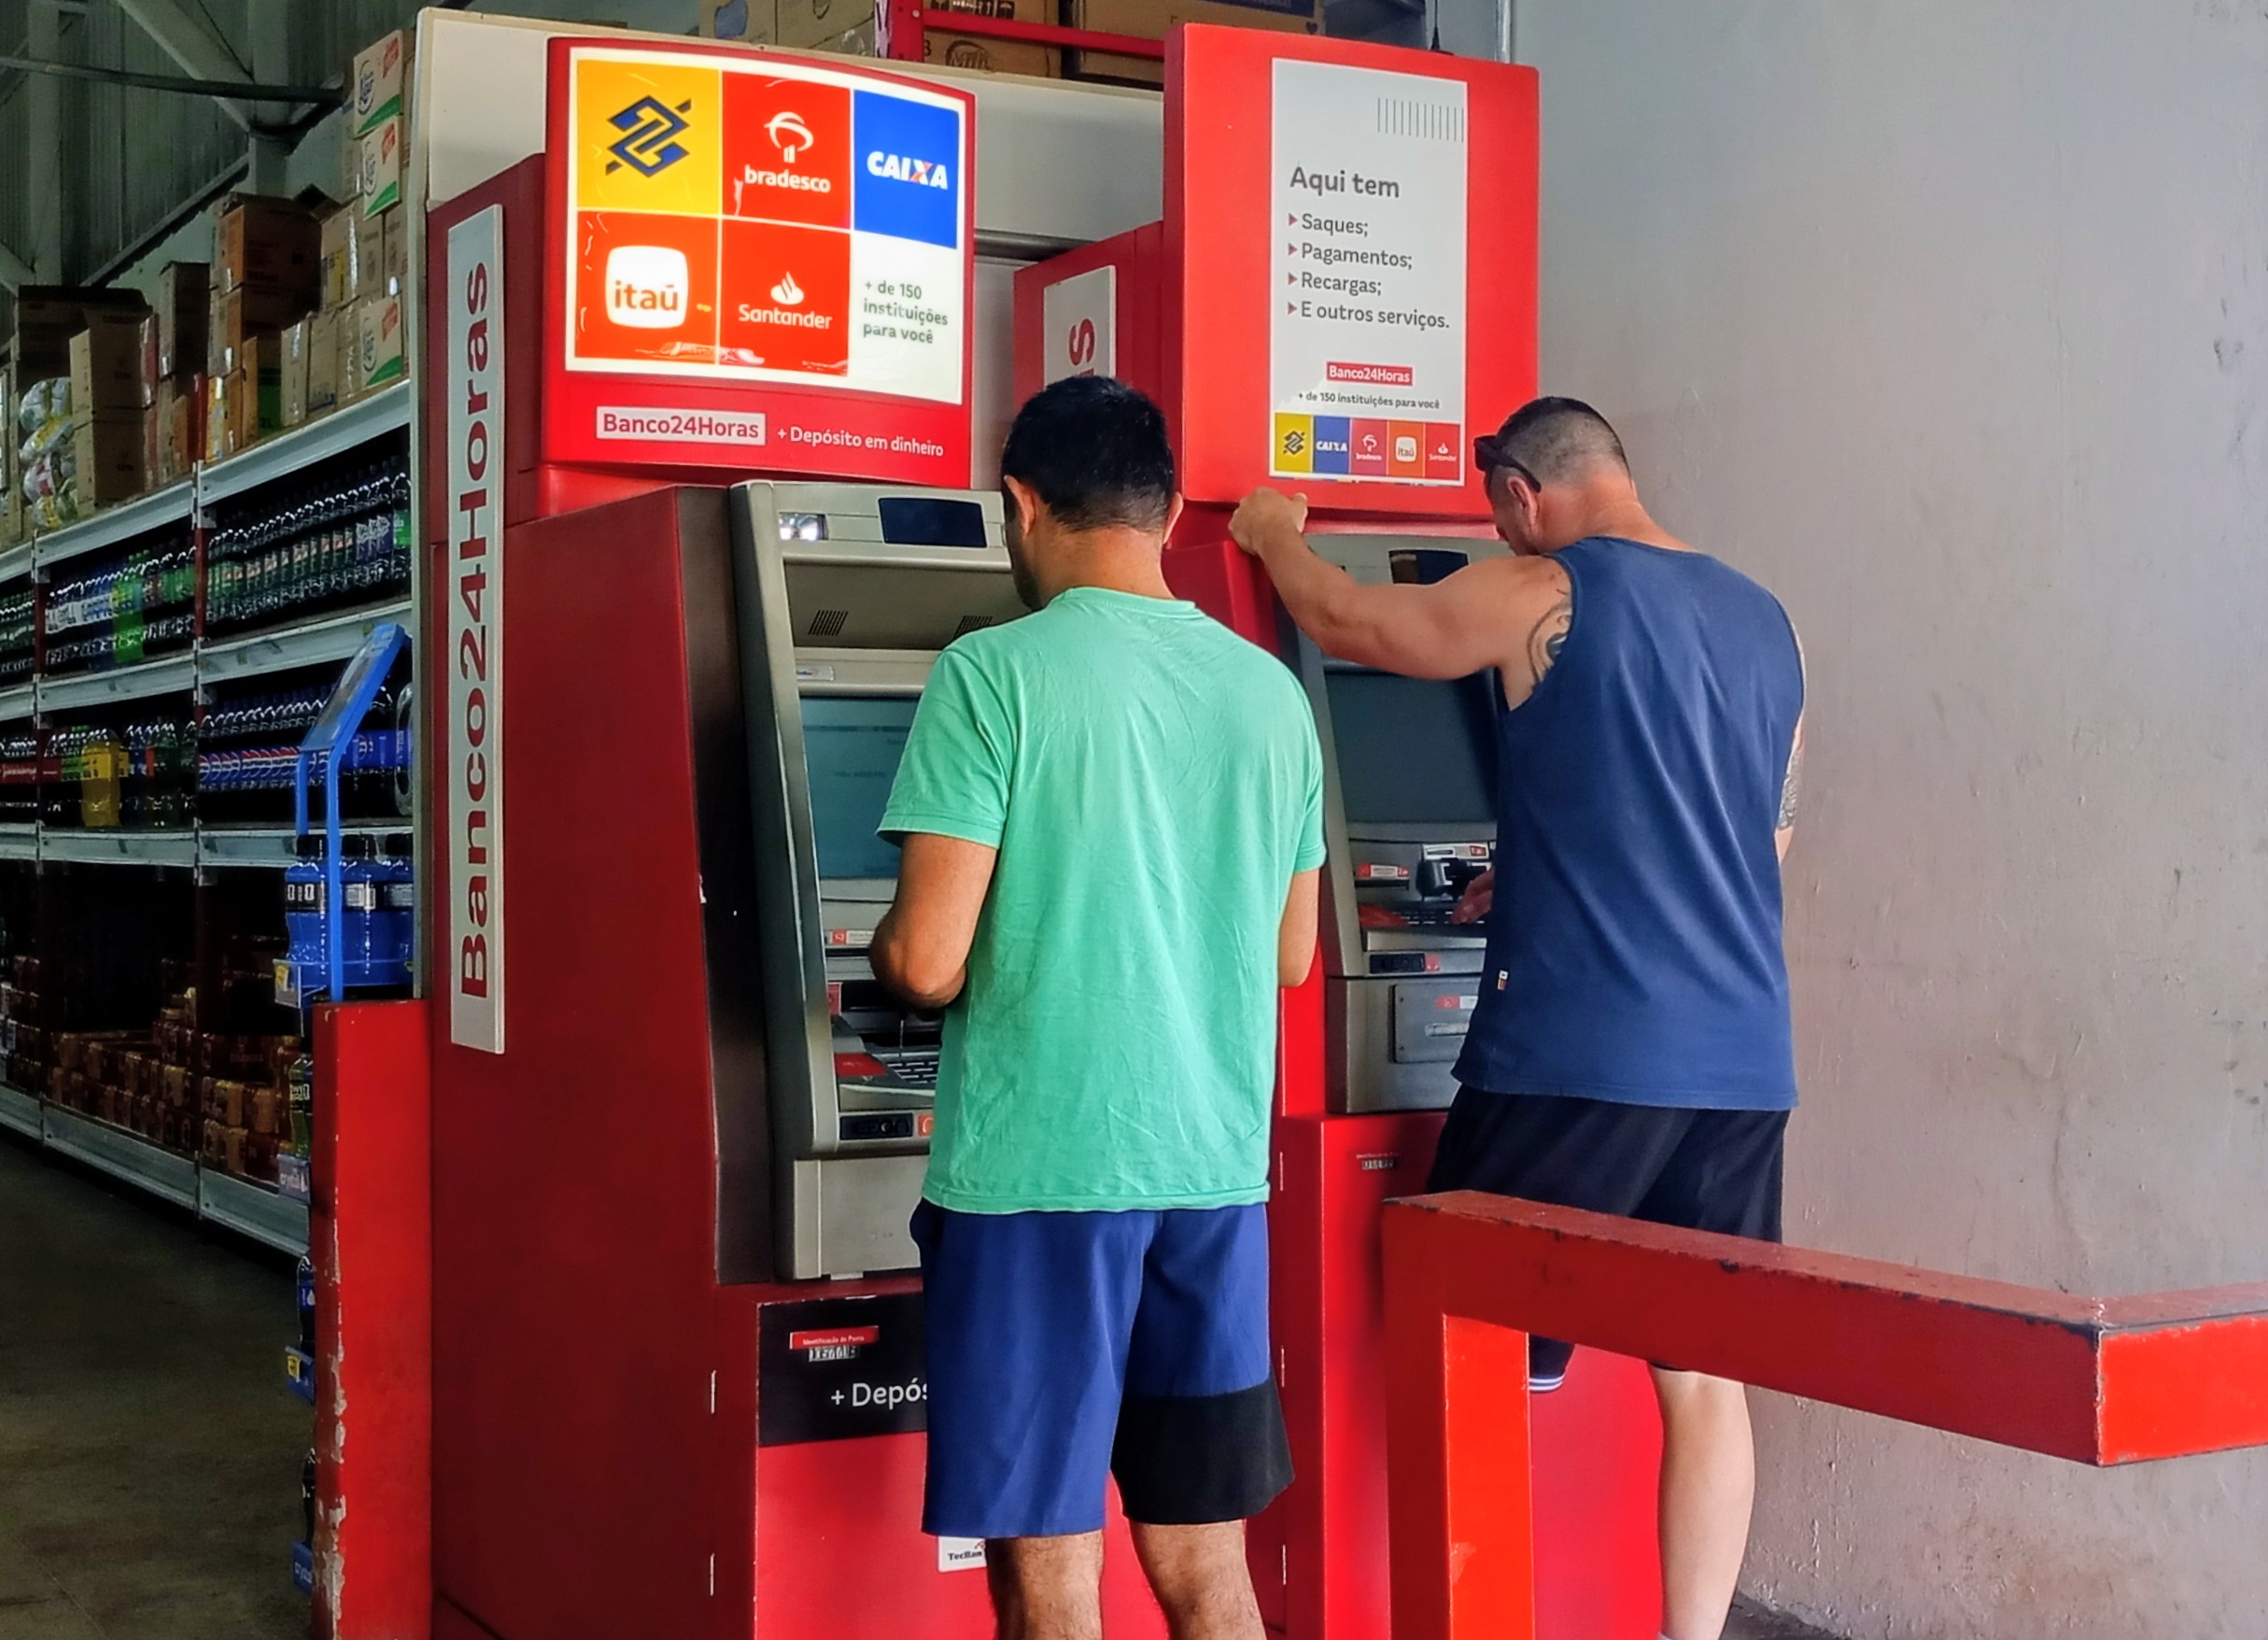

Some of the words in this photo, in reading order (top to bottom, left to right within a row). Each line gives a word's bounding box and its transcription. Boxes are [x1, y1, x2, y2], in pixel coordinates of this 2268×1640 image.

[744, 164, 831, 193] bradesco
[866, 151, 949, 190] CAIXA
[1289, 165, 1345, 197] Aqui
[1352, 173, 1400, 198] tem
[1302, 213, 1369, 238] Saques;
[1302, 242, 1413, 270] Pagamentos;
[613, 279, 679, 312] itaú
[878, 280, 895, 295] de
[899, 282, 923, 300] 150
[1301, 272, 1382, 297] Recargas;
[739, 304, 832, 330] Santander
[863, 299, 949, 327] instituições
[1301, 301, 1312, 318] E
[1317, 304, 1373, 323] outros
[1377, 309, 1450, 332] serviços.
[863, 322, 897, 340] para
[901, 328, 934, 344] você
[1329, 365, 1411, 383] Banco24Horas
[1306, 391, 1318, 402] de
[1320, 392, 1336, 403] 150
[1337, 393, 1394, 408] instituições
[1395, 399, 1416, 409] para
[1418, 399, 1441, 409] você
[603, 413, 759, 439] Banco24Horas
[790, 426, 862, 448] Depósito
[865, 436, 888, 451] em
[891, 436, 944, 457] dinheiro
[1316, 440, 1348, 452] CAIXA
[459, 262, 487, 998] Banco24Horas
